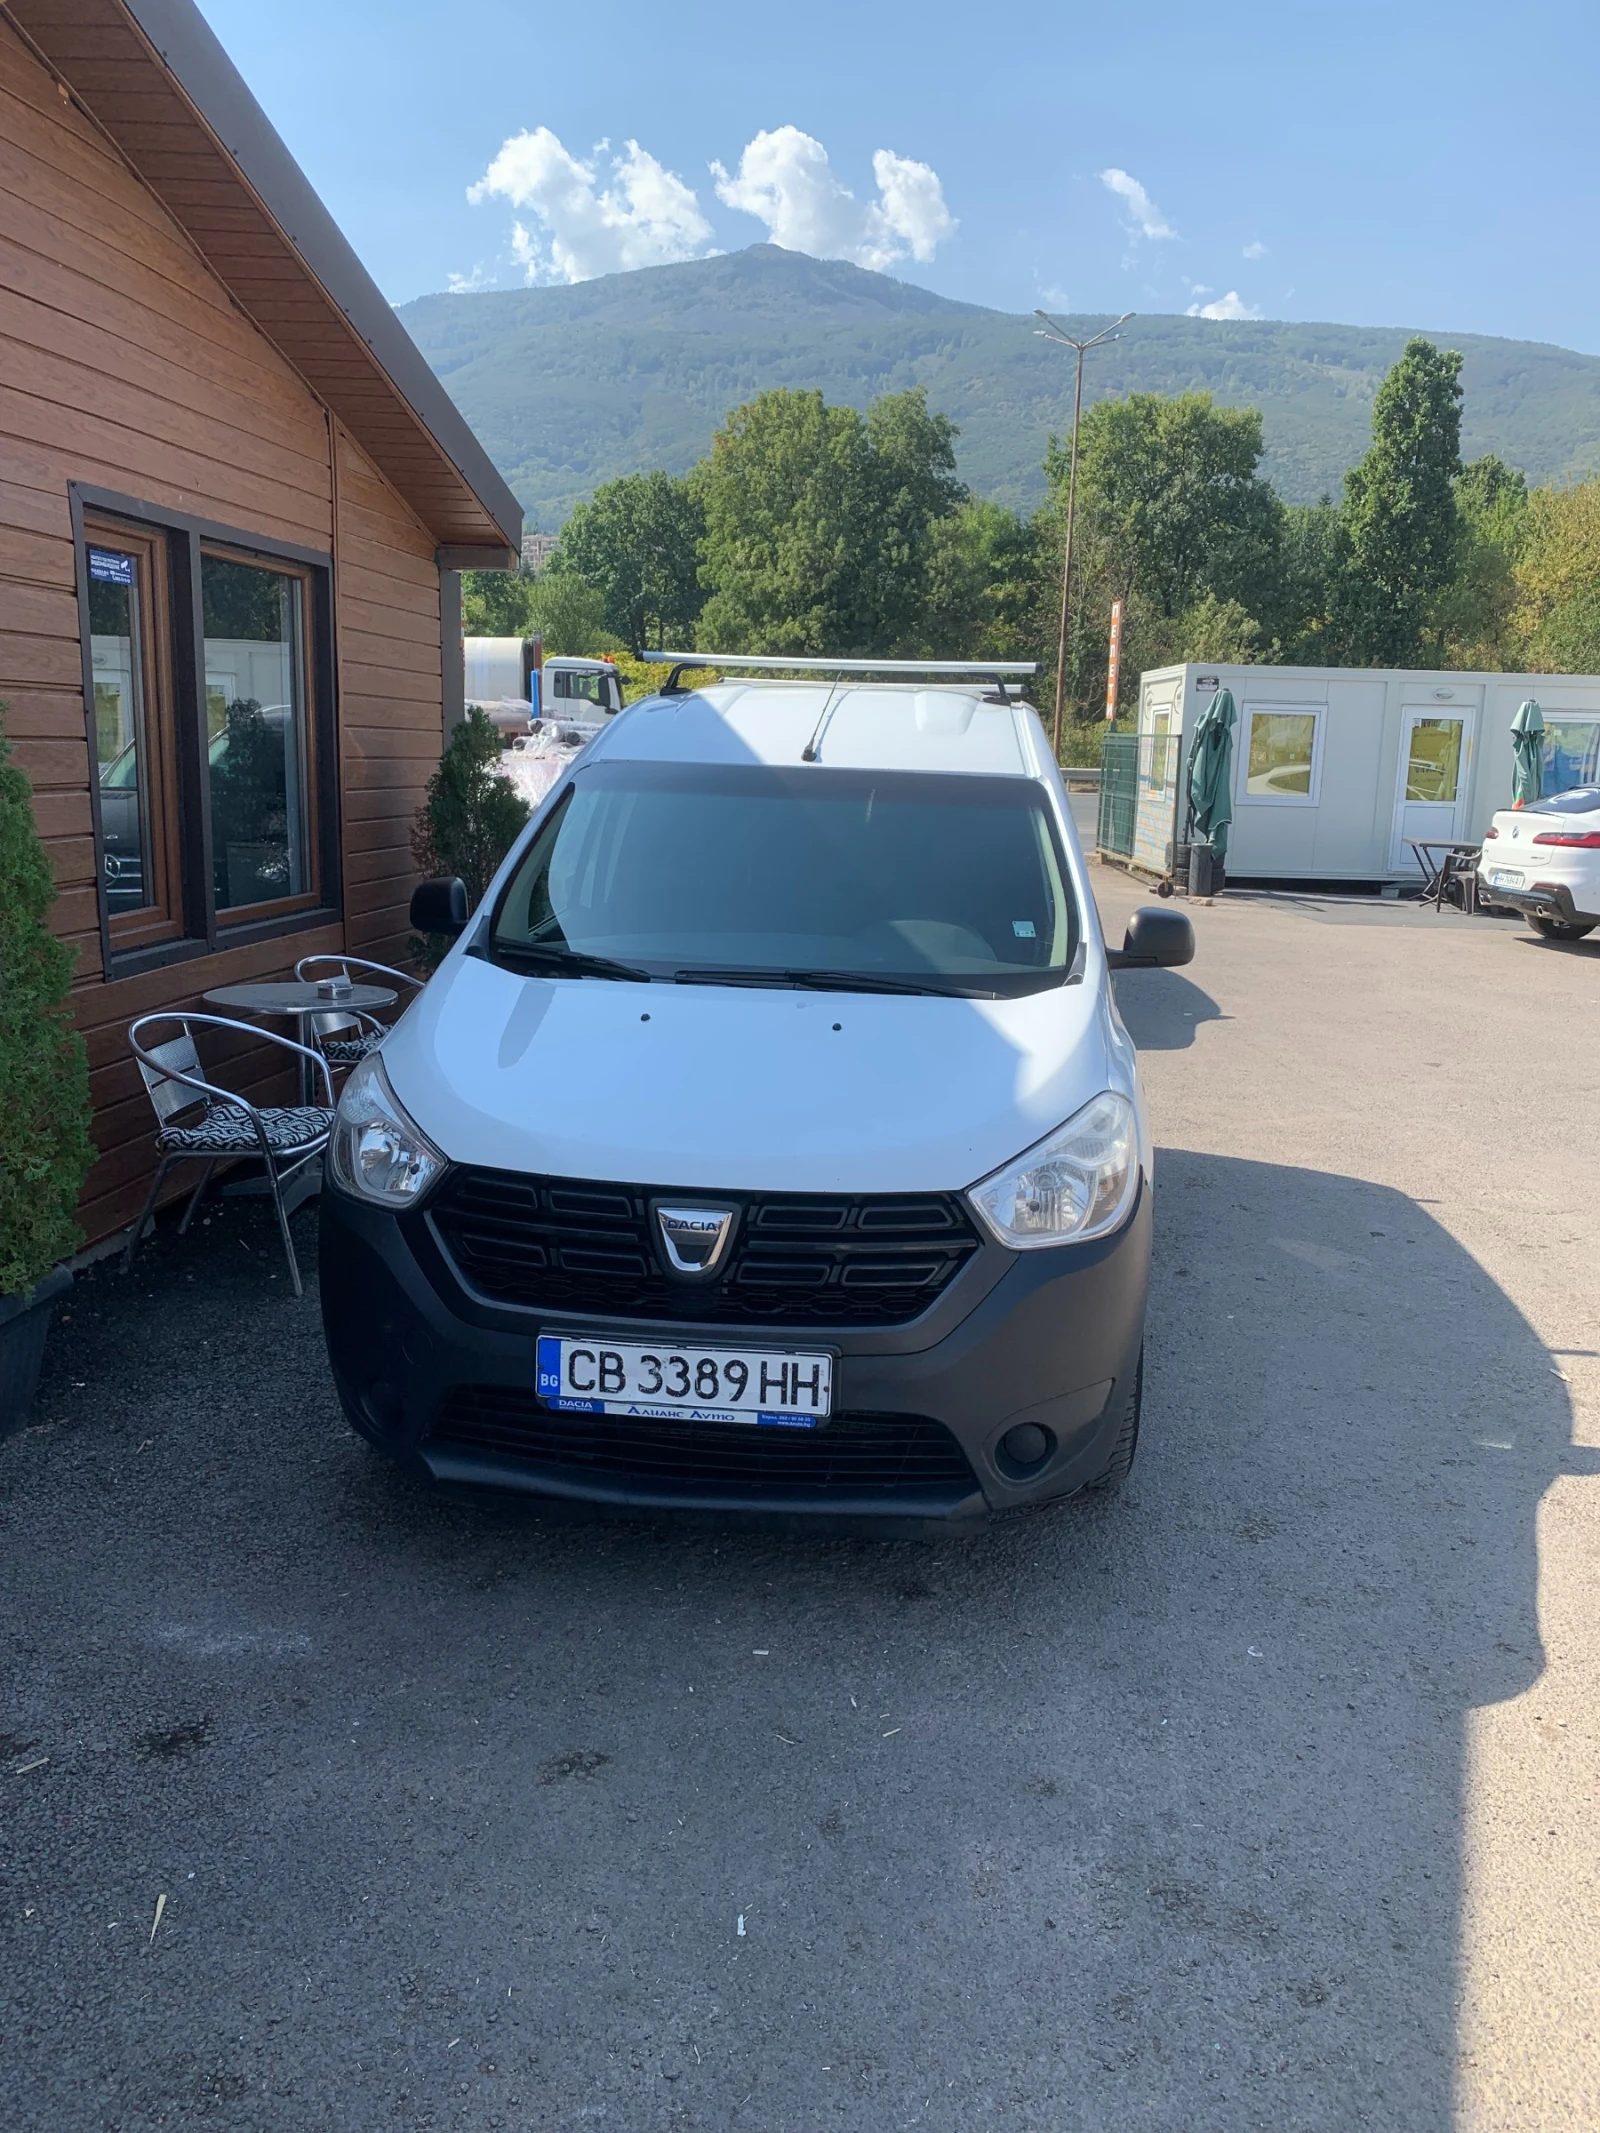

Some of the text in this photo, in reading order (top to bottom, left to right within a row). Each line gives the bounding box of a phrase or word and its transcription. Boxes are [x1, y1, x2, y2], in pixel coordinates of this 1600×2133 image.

[1106, 604, 1119, 719] ПЕЛЕТИ
[667, 1219, 717, 1232] DACIA
[540, 1373, 558, 1387] BG
[568, 1349, 820, 1407] CB 3389 HH
[558, 1400, 593, 1409] DACIA
